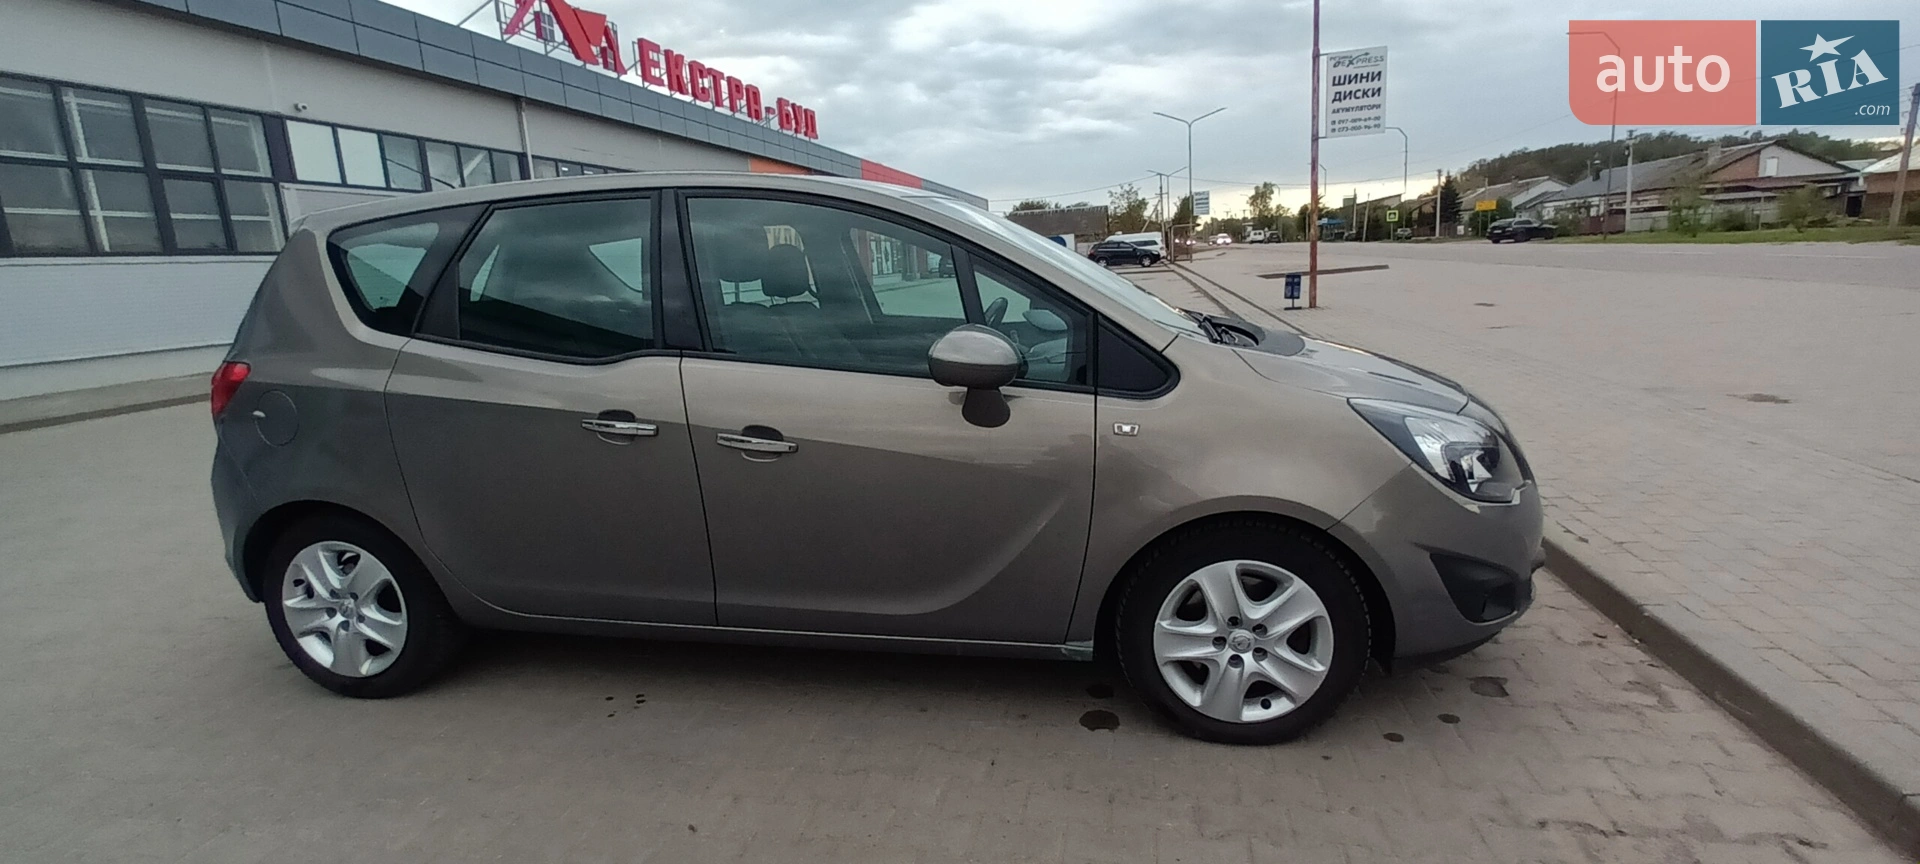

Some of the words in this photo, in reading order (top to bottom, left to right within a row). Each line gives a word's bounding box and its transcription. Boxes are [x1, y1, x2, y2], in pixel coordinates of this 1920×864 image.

[1332, 70, 1382, 87] ШИНИ
[637, 37, 819, 139] ЕКСТРА-БУД
[1331, 86, 1382, 104] ДИСКИ
[1331, 103, 1382, 114] АКУМУЛЯТОРИ
